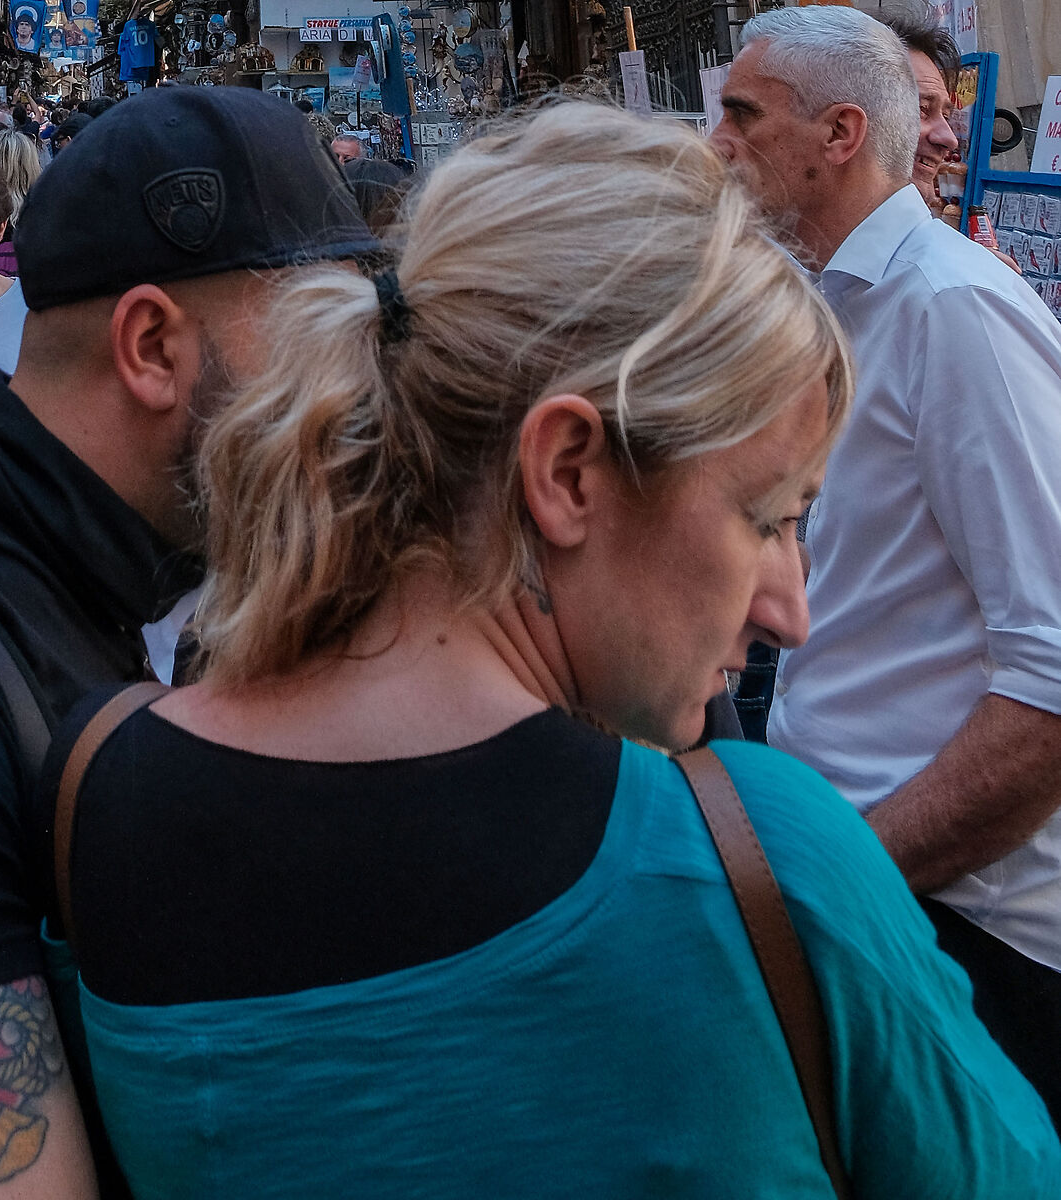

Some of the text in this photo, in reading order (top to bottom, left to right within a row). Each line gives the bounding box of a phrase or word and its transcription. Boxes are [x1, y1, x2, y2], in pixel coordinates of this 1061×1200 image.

[307, 18, 339, 28] STATUE
[131, 30, 148, 47] 10
[301, 29, 331, 40] ARIA
